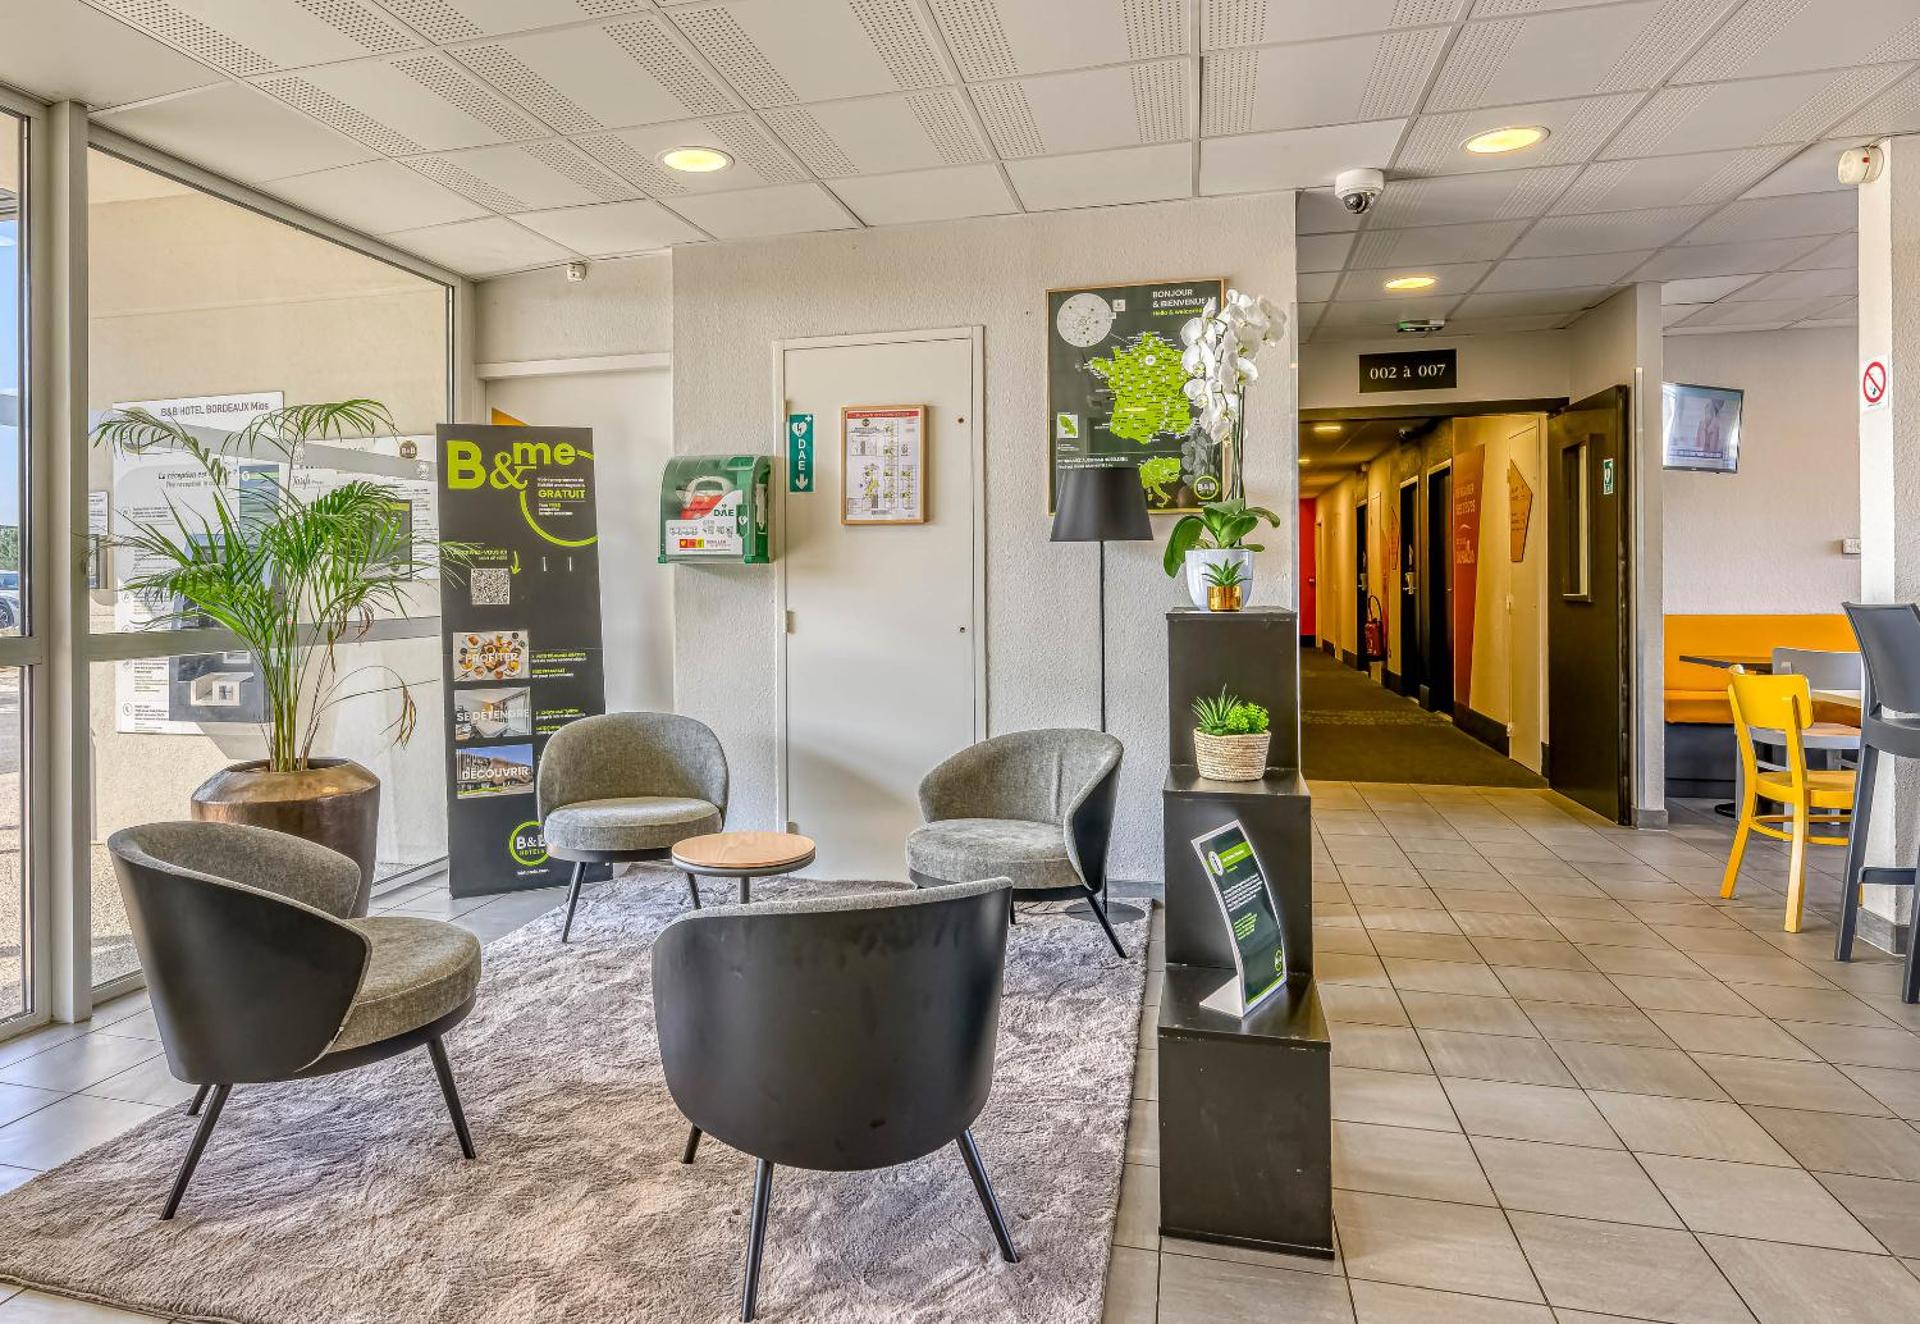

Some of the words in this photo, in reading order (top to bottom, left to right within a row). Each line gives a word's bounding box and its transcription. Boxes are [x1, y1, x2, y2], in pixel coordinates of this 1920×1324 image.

[1152, 289, 1193, 298] BONJOUR
[1152, 300, 1159, 308] &
[1160, 297, 1205, 308] BIENVENUE
[1369, 366, 1397, 380] 002
[1403, 365, 1411, 378] à
[1418, 364, 1446, 377] 007
[160, 407, 178, 417] B&B
[179, 406, 205, 416] HOTEL
[205, 403, 250, 414] BORDEAUX
[797, 438, 807, 471] DAE
[538, 489, 586, 499] GRATUIT
[713, 509, 735, 517] DAE
[465, 652, 520, 664] PROFITER
[456, 712, 470, 722] SE
